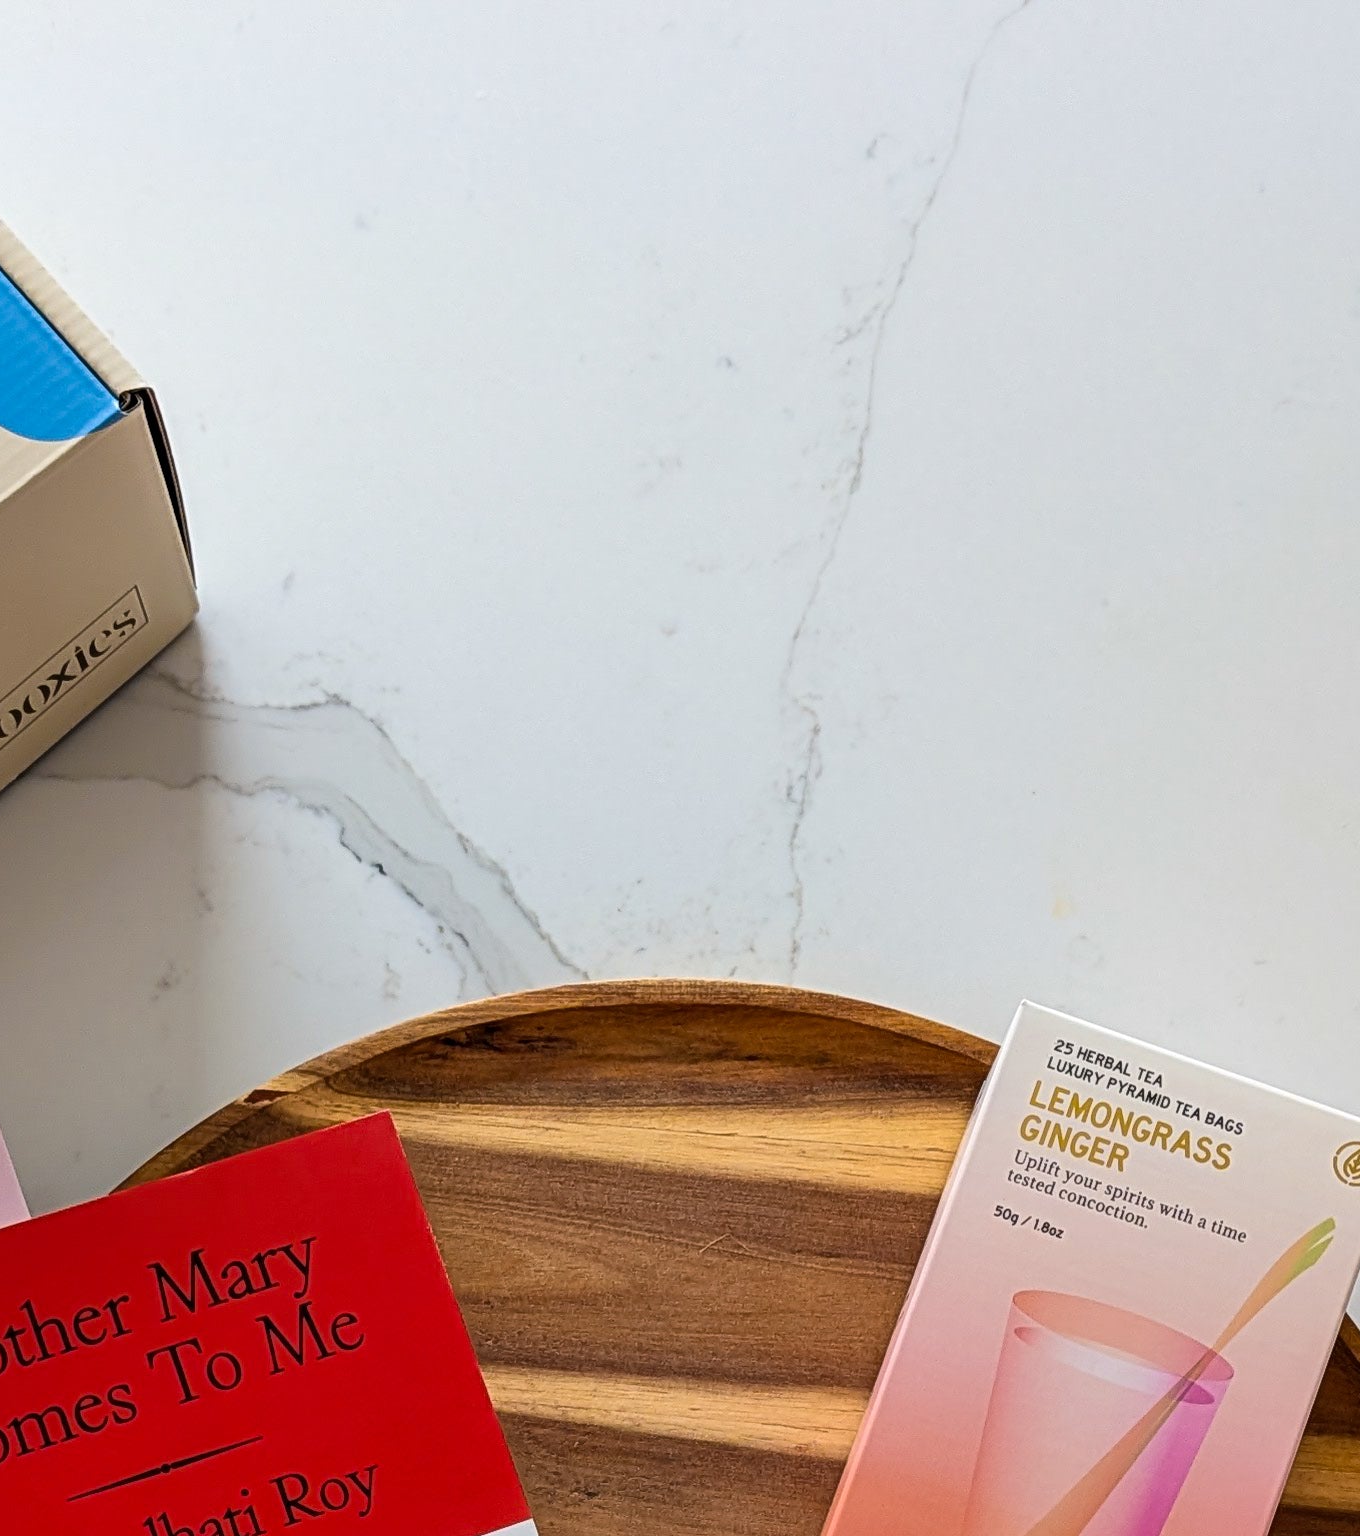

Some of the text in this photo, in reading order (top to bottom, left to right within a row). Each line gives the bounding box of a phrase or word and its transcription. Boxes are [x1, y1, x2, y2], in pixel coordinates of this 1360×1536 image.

[1047, 1056, 1244, 1135] LUXURY PYRAMID TEA BAGS
[1053, 1039, 1164, 1088] 25 HERBAL TEA
[1020, 1114, 1130, 1172] GINGER
[1029, 1080, 1233, 1170] LEMONGRASS
[993, 1205, 1019, 1226] 50g
[1033, 1218, 1065, 1239] 1.8oz
[1007, 1169, 1149, 1229] tested concoction.
[1014, 1149, 1247, 1243] Uplift your spirits with a time
[146, 1236, 318, 1323] Mary
[146, 1337, 243, 1404] To
[255, 1301, 365, 1376] Me
[270, 1464, 379, 1528] Roy
